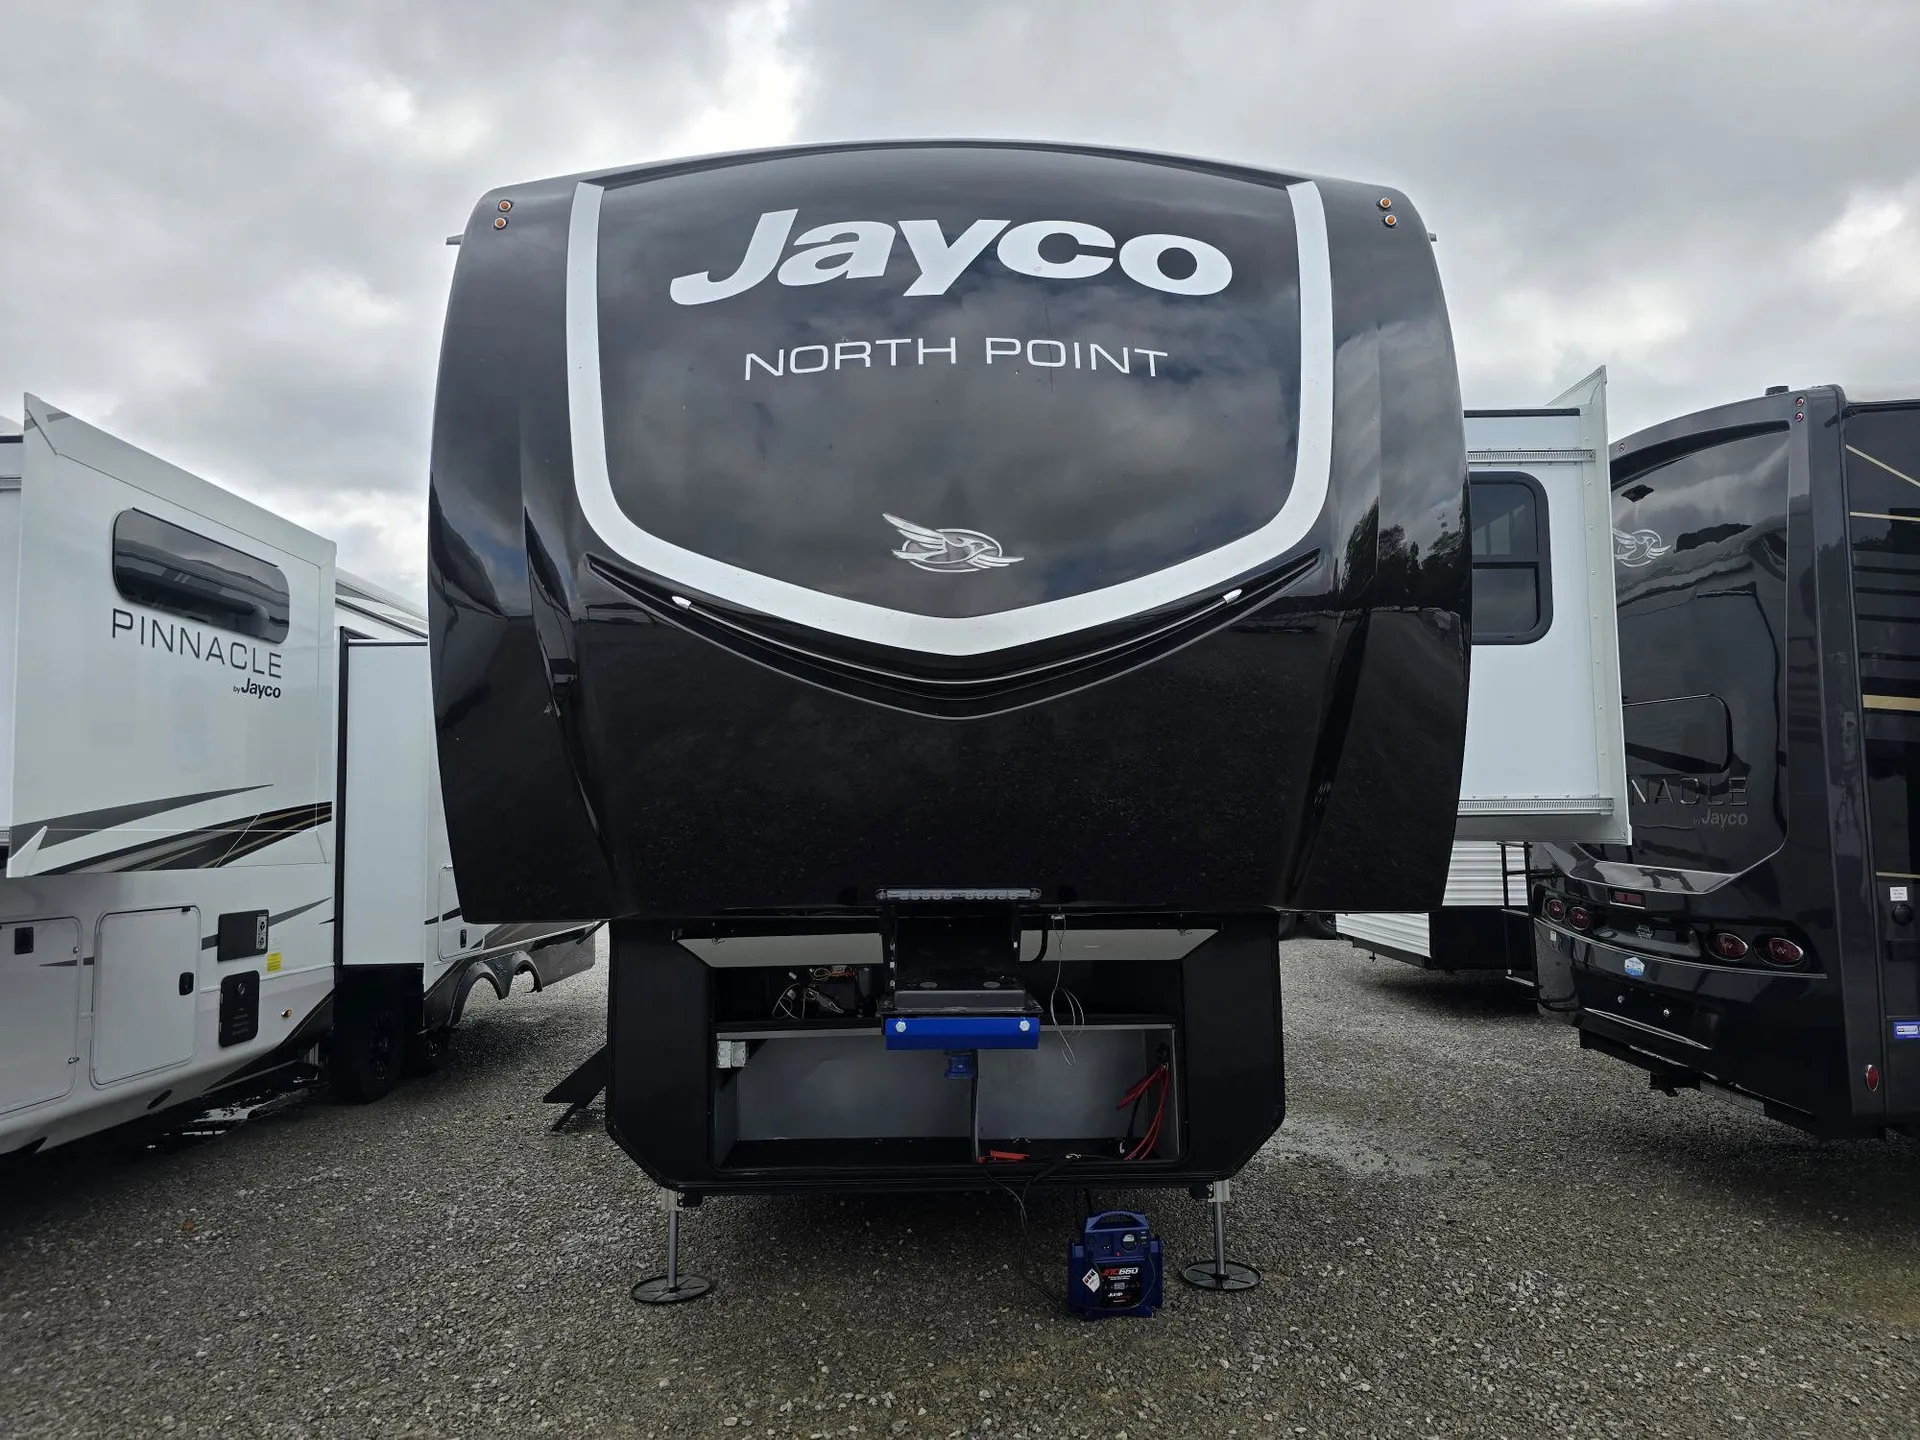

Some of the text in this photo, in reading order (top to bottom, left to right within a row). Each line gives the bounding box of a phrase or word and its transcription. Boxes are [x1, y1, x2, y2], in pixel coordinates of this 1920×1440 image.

[670, 209, 1232, 304] Jayco
[745, 337, 1168, 382] NORTH POINT
[112, 608, 282, 678] PINNACLE
[233, 677, 281, 699] by Jayco
[1702, 808, 1748, 828] Jayco
